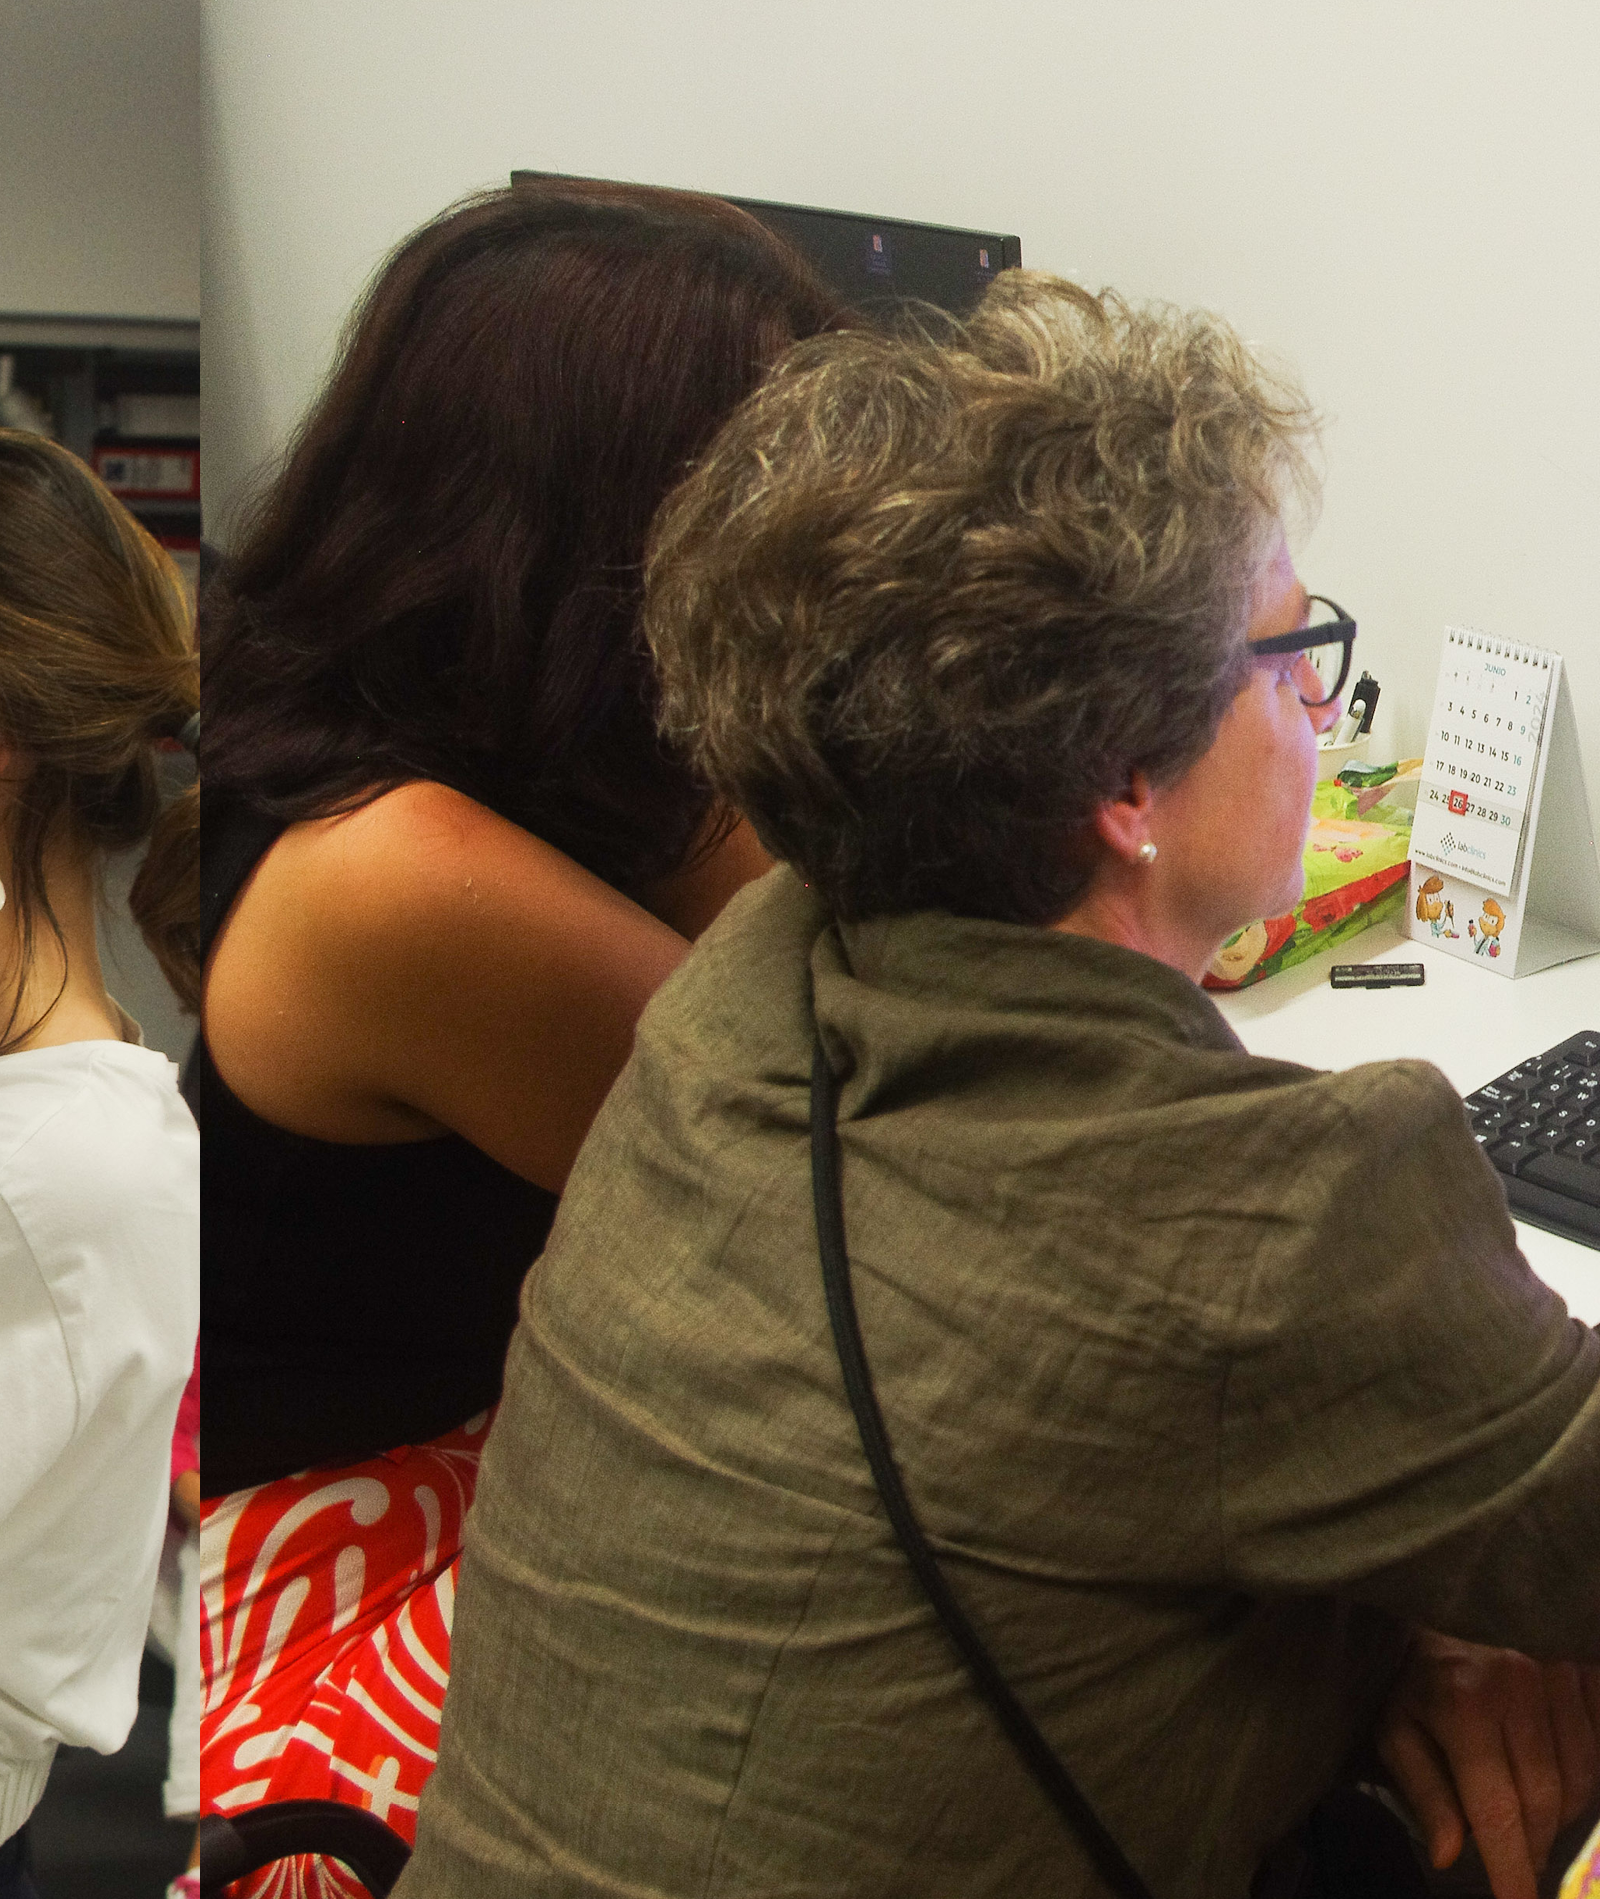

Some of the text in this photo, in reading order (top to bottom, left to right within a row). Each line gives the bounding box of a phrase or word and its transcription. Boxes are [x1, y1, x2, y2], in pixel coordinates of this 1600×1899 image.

[1484, 663, 1506, 676] JUNIO
[1441, 730, 1522, 766] 10 11 12 13 14 15 16
[1436, 760, 1504, 792] 17 18 19 20 21 22
[1458, 841, 1486, 860] labclinics
